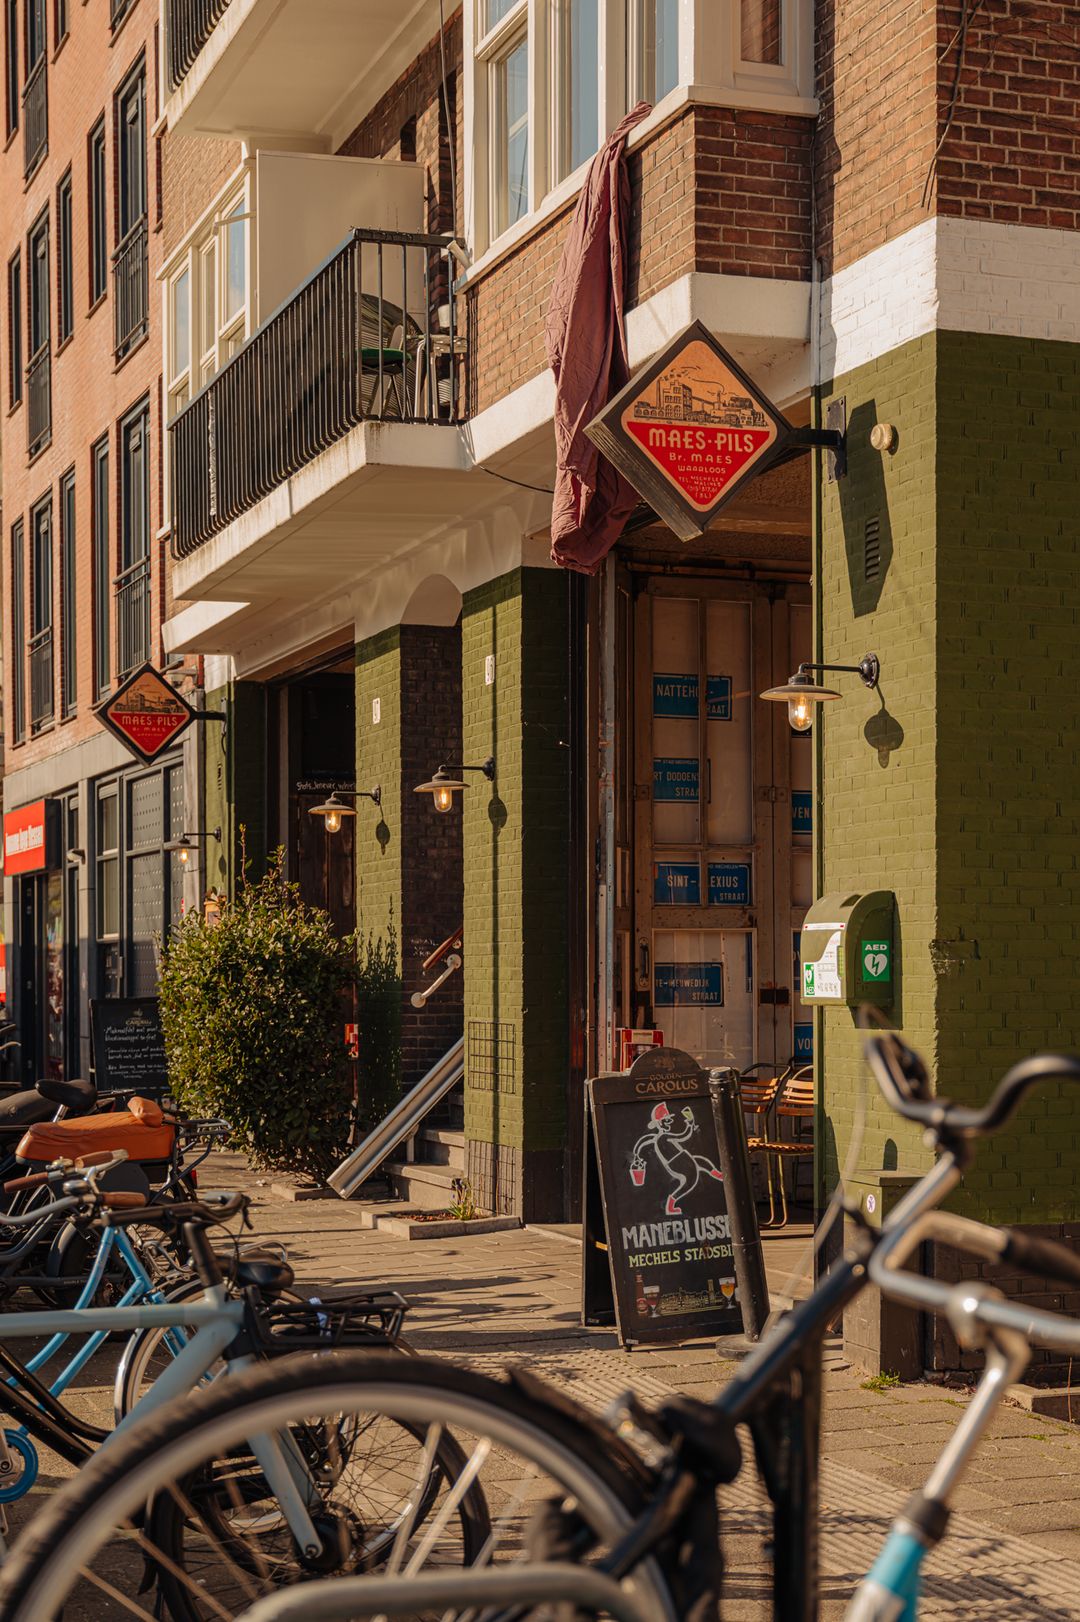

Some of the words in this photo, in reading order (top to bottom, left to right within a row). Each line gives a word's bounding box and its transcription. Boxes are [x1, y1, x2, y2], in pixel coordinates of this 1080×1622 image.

[669, 452, 686, 462] Br.
[691, 453, 732, 465] MAES
[677, 465, 727, 474] WAARLOOS
[792, 806, 812, 818] VEN
[719, 892, 745, 901] STRAAT
[692, 991, 718, 1001] STRAAT
[797, 1037, 813, 1051] VO
[649, 1072, 683, 1081] GOUDEN
[635, 1079, 698, 1095] CAROLUS
[628, 1250, 681, 1268] MECHELS
[685, 1243, 735, 1262] STADSBI
